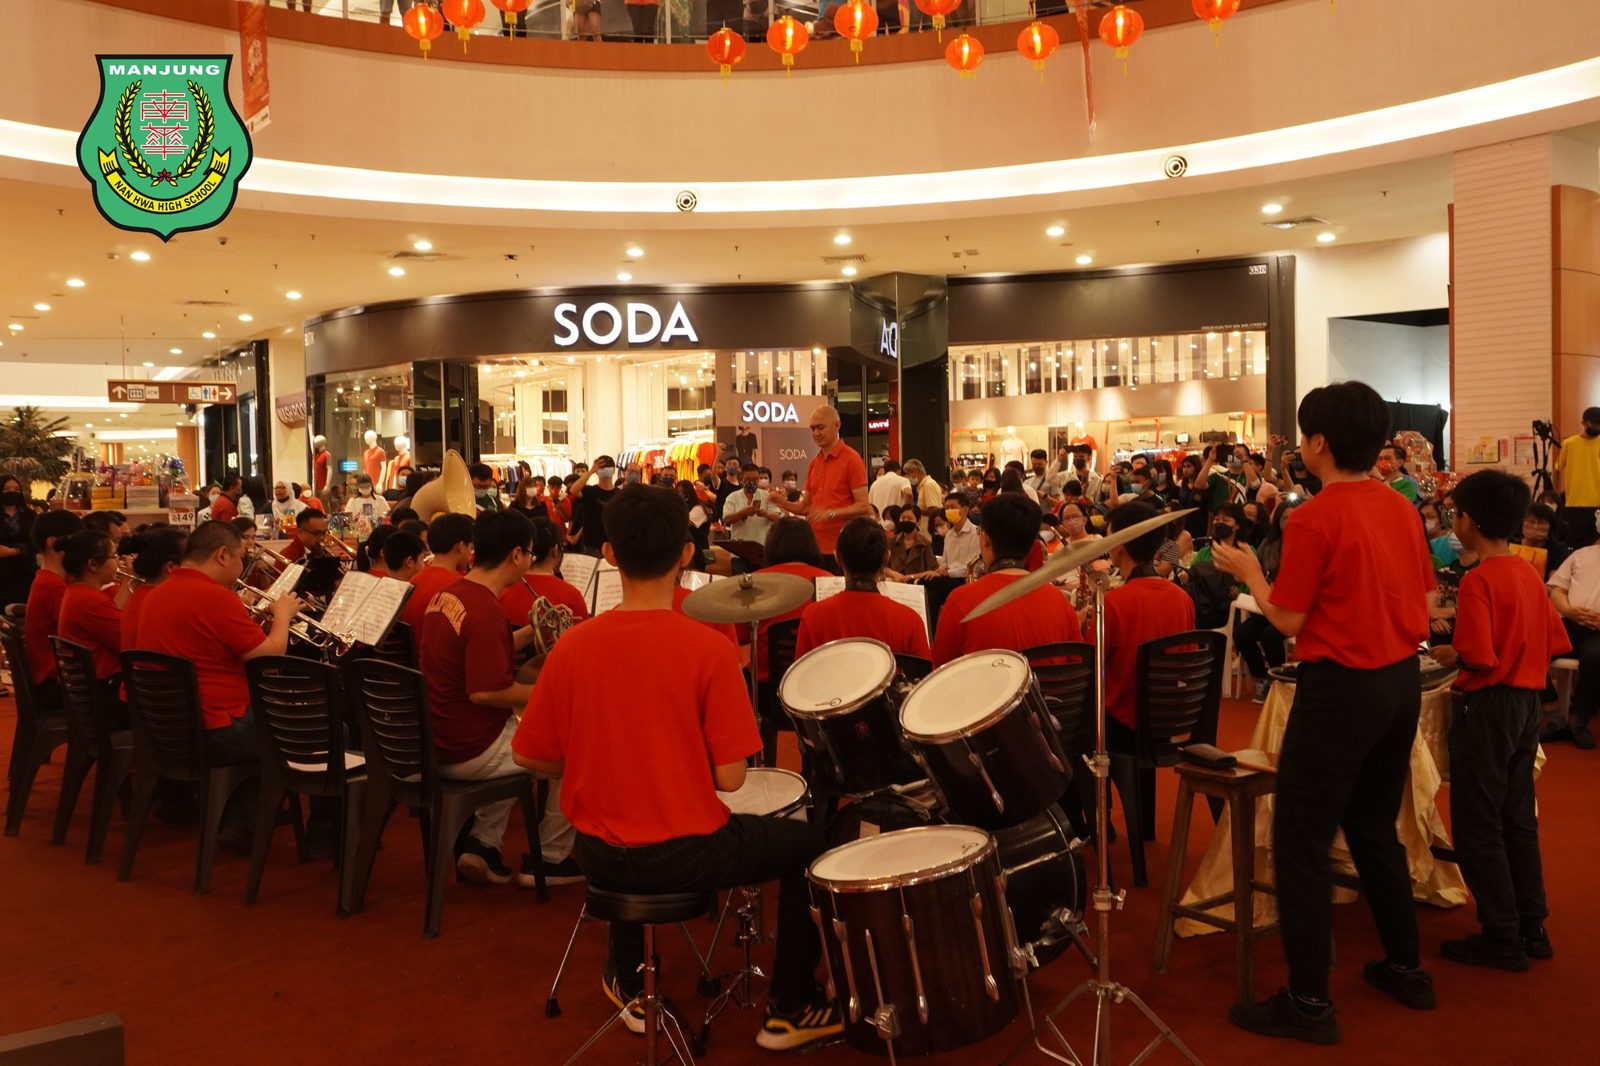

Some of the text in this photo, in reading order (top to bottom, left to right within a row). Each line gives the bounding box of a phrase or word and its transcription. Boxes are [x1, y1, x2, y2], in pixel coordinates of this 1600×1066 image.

[553, 300, 699, 346] SODA
[742, 400, 799, 422] SODA
[780, 449, 807, 460] SODA
